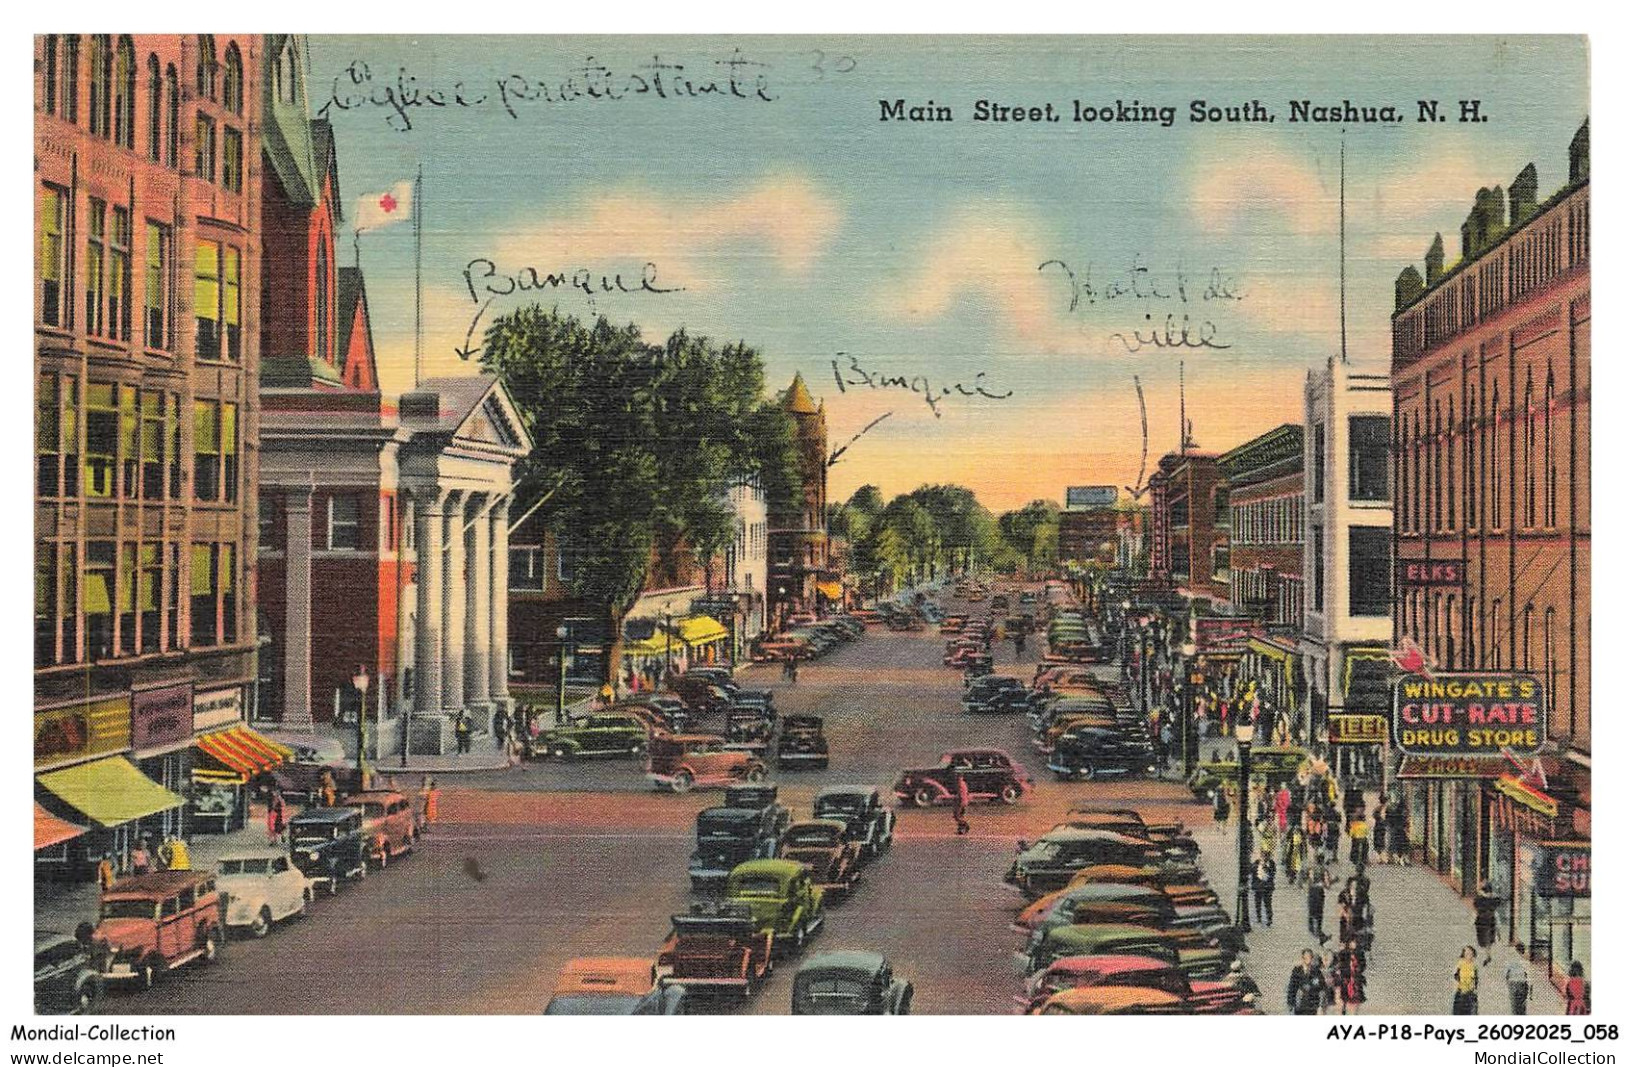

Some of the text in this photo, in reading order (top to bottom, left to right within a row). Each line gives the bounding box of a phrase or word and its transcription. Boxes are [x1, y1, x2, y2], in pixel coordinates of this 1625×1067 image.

[463, 258, 687, 316] Banque
[1108, 313, 1232, 353] ville
[832, 352, 1014, 419] Banque
[1406, 564, 1456, 581] ELKS
[1403, 680, 1536, 699] WINGATE'S
[1402, 702, 1538, 725] CUT-RATE
[1403, 729, 1538, 747] DRUG STORE
[1556, 852, 1591, 872] CH
[1555, 872, 1591, 893] SU
